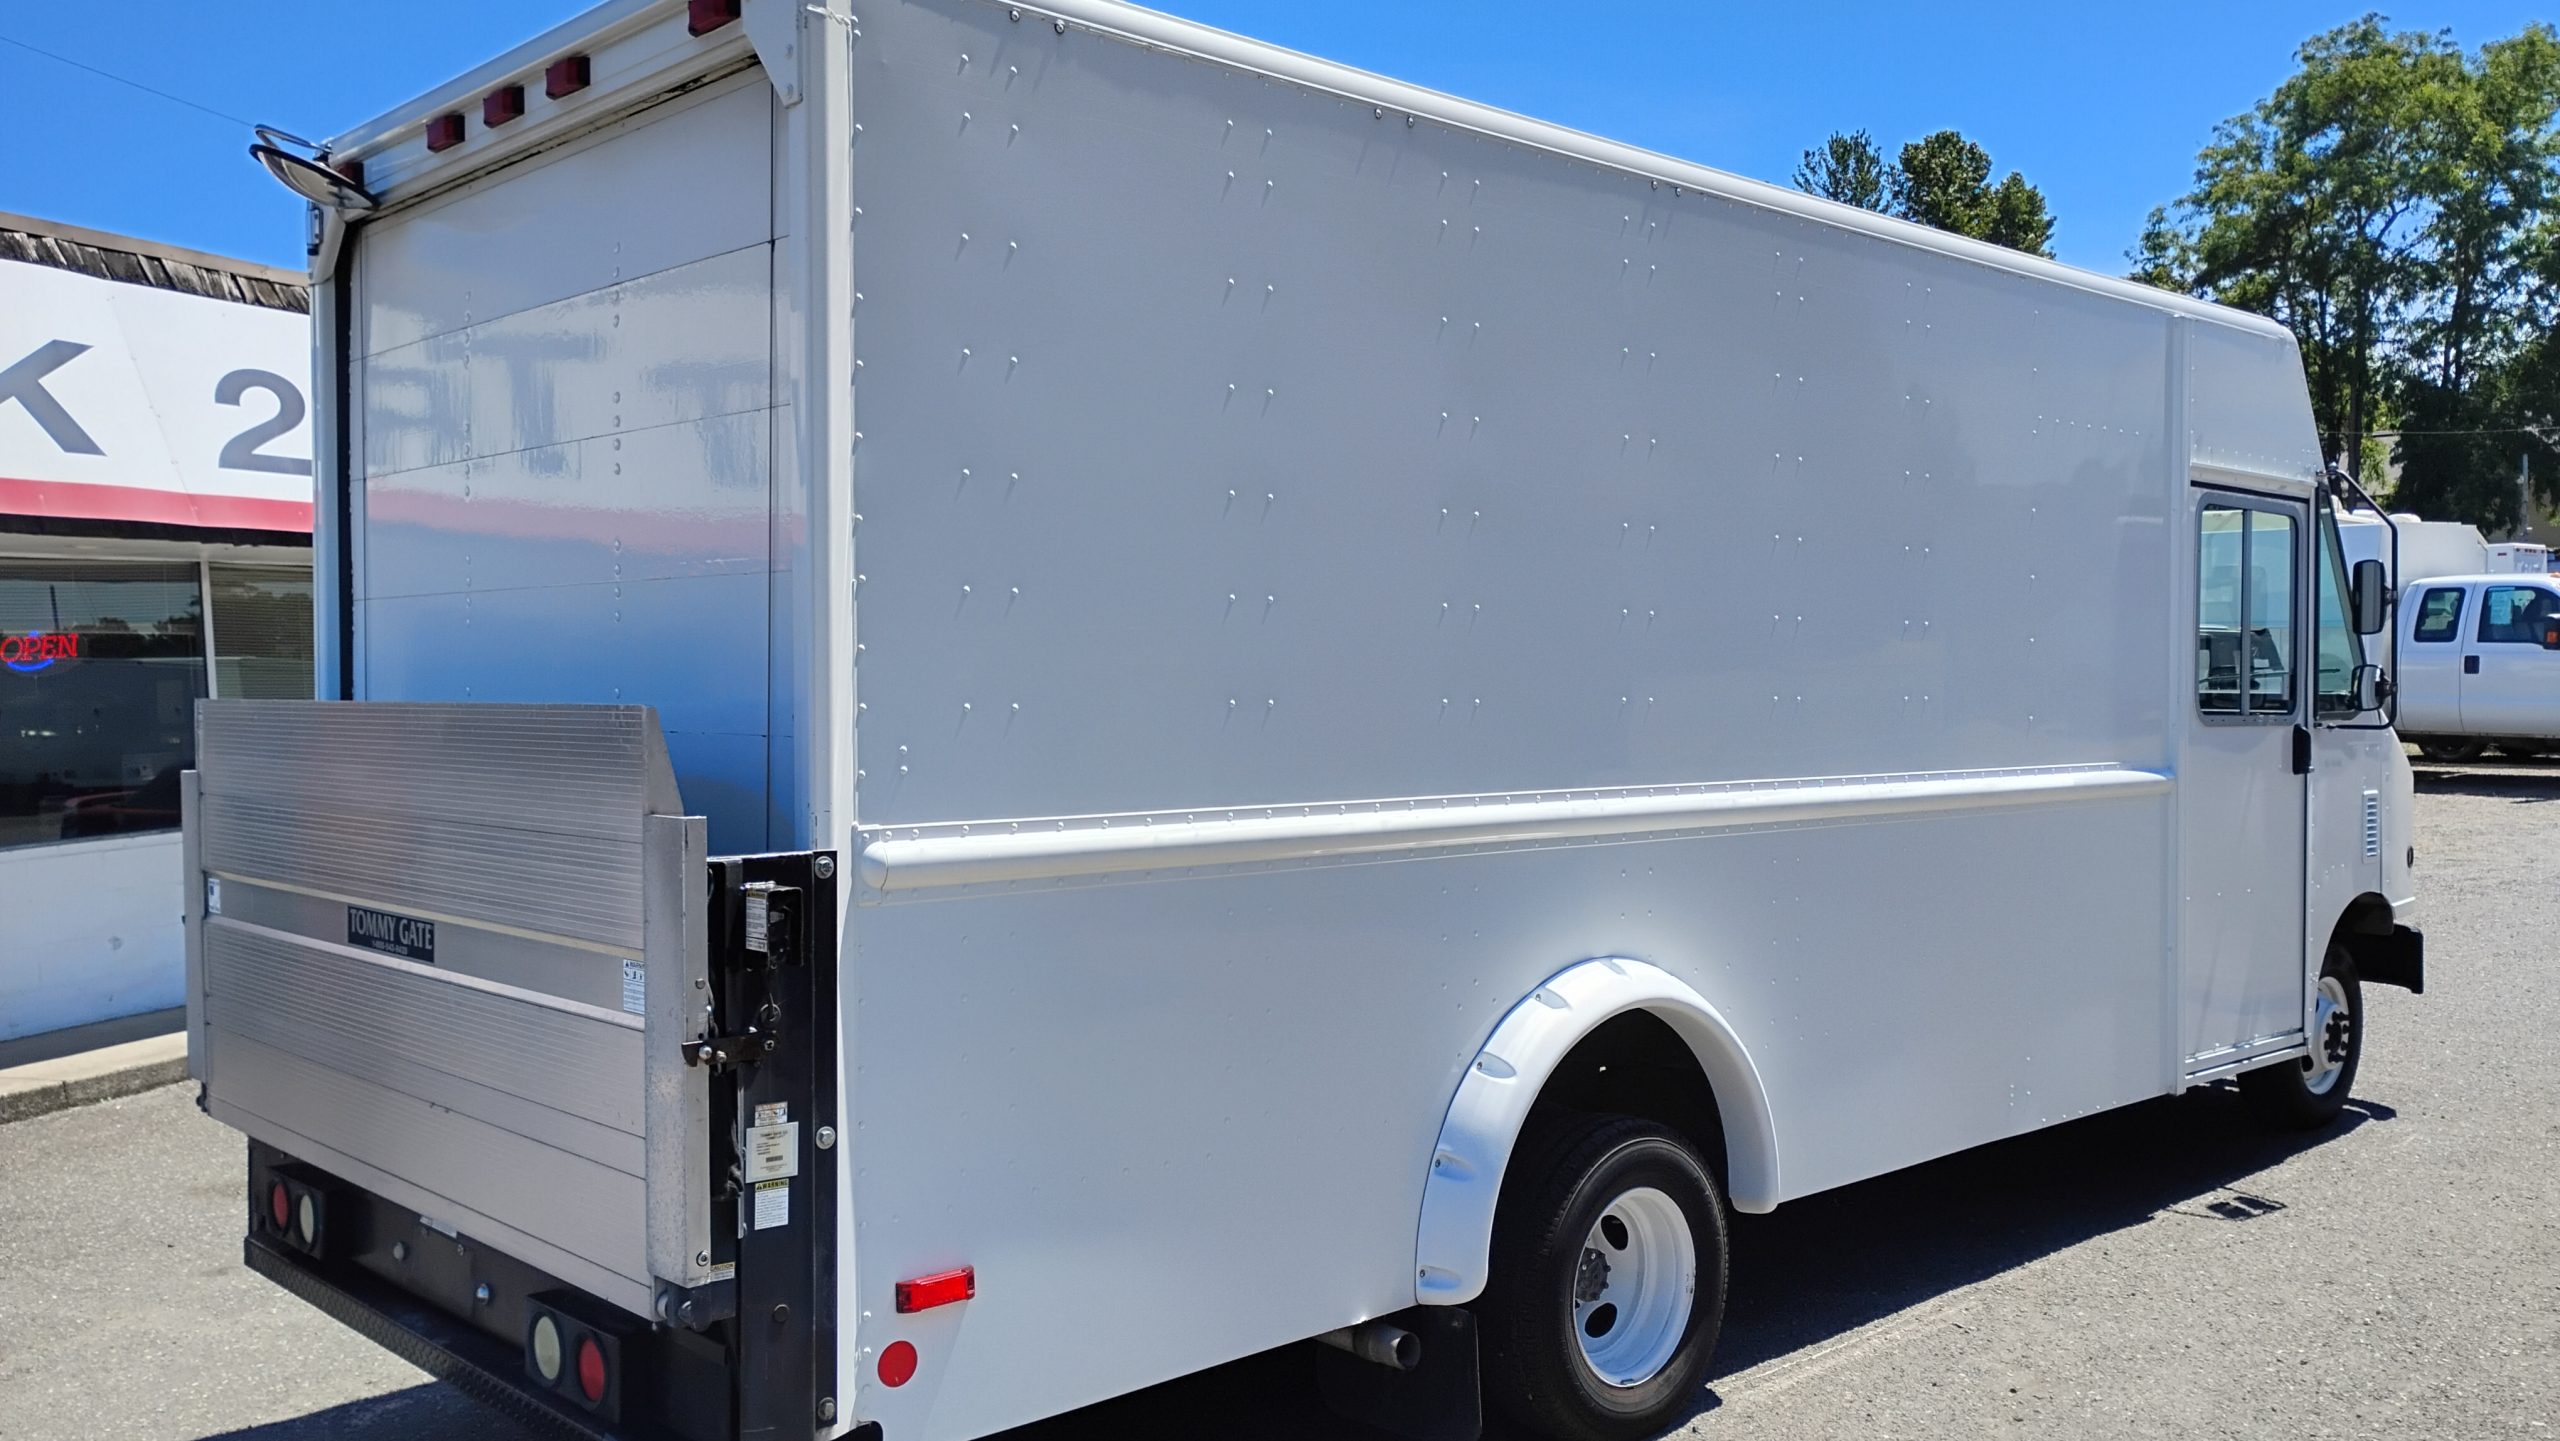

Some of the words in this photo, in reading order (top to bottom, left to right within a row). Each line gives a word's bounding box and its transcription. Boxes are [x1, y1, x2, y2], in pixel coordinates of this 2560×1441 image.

[215, 368, 312, 476] 2
[0, 632, 78, 663] OPEN
[350, 908, 396, 942] TOMMY
[399, 918, 433, 950] GATE
